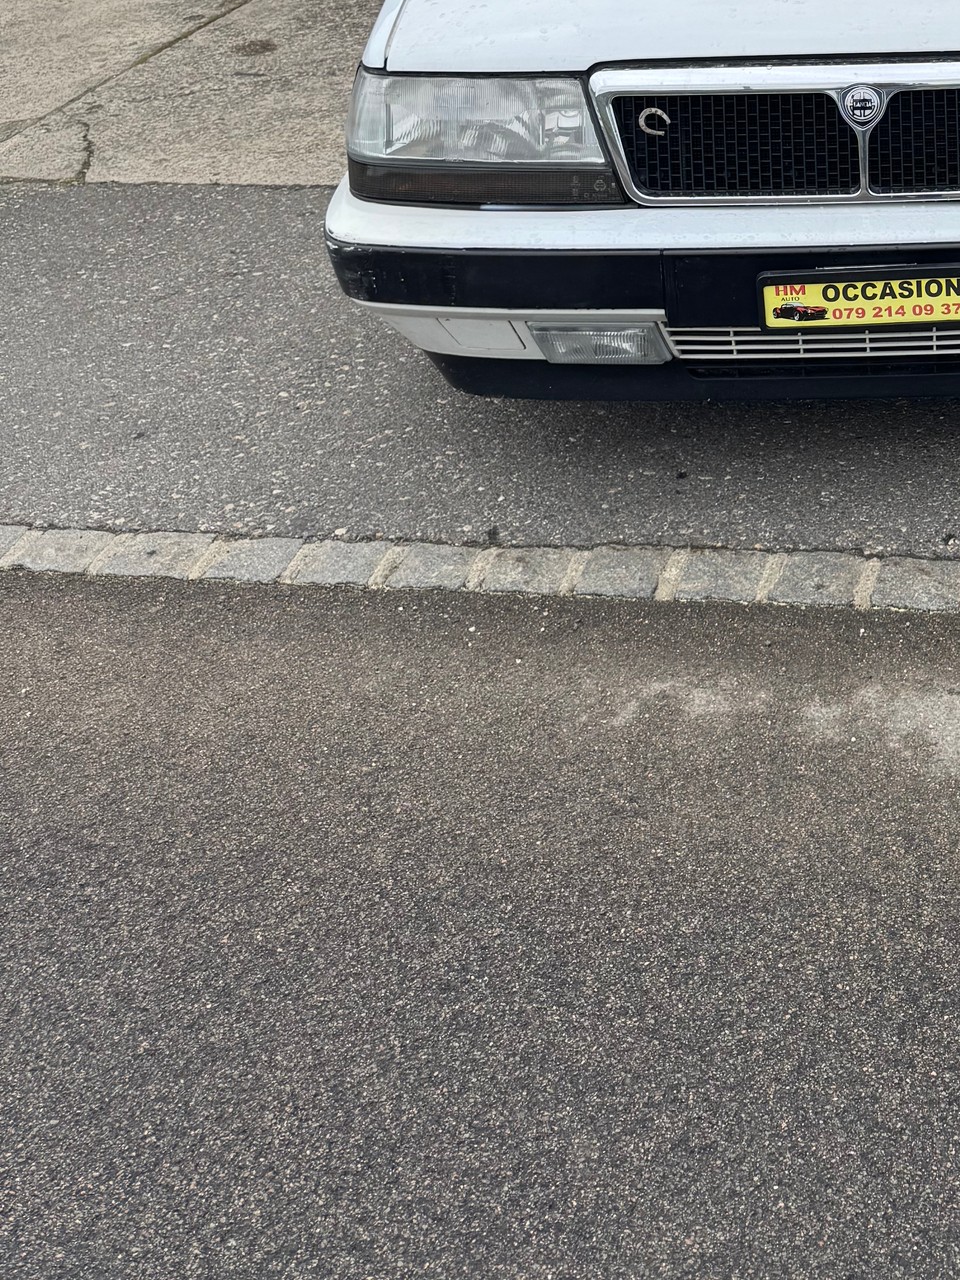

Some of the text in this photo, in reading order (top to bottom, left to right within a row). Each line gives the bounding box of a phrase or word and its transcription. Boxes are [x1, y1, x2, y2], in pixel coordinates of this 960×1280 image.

[774, 284, 806, 297] HM
[832, 307, 866, 320] 079
[872, 305, 906, 319] 214
[912, 304, 934, 317] 09
